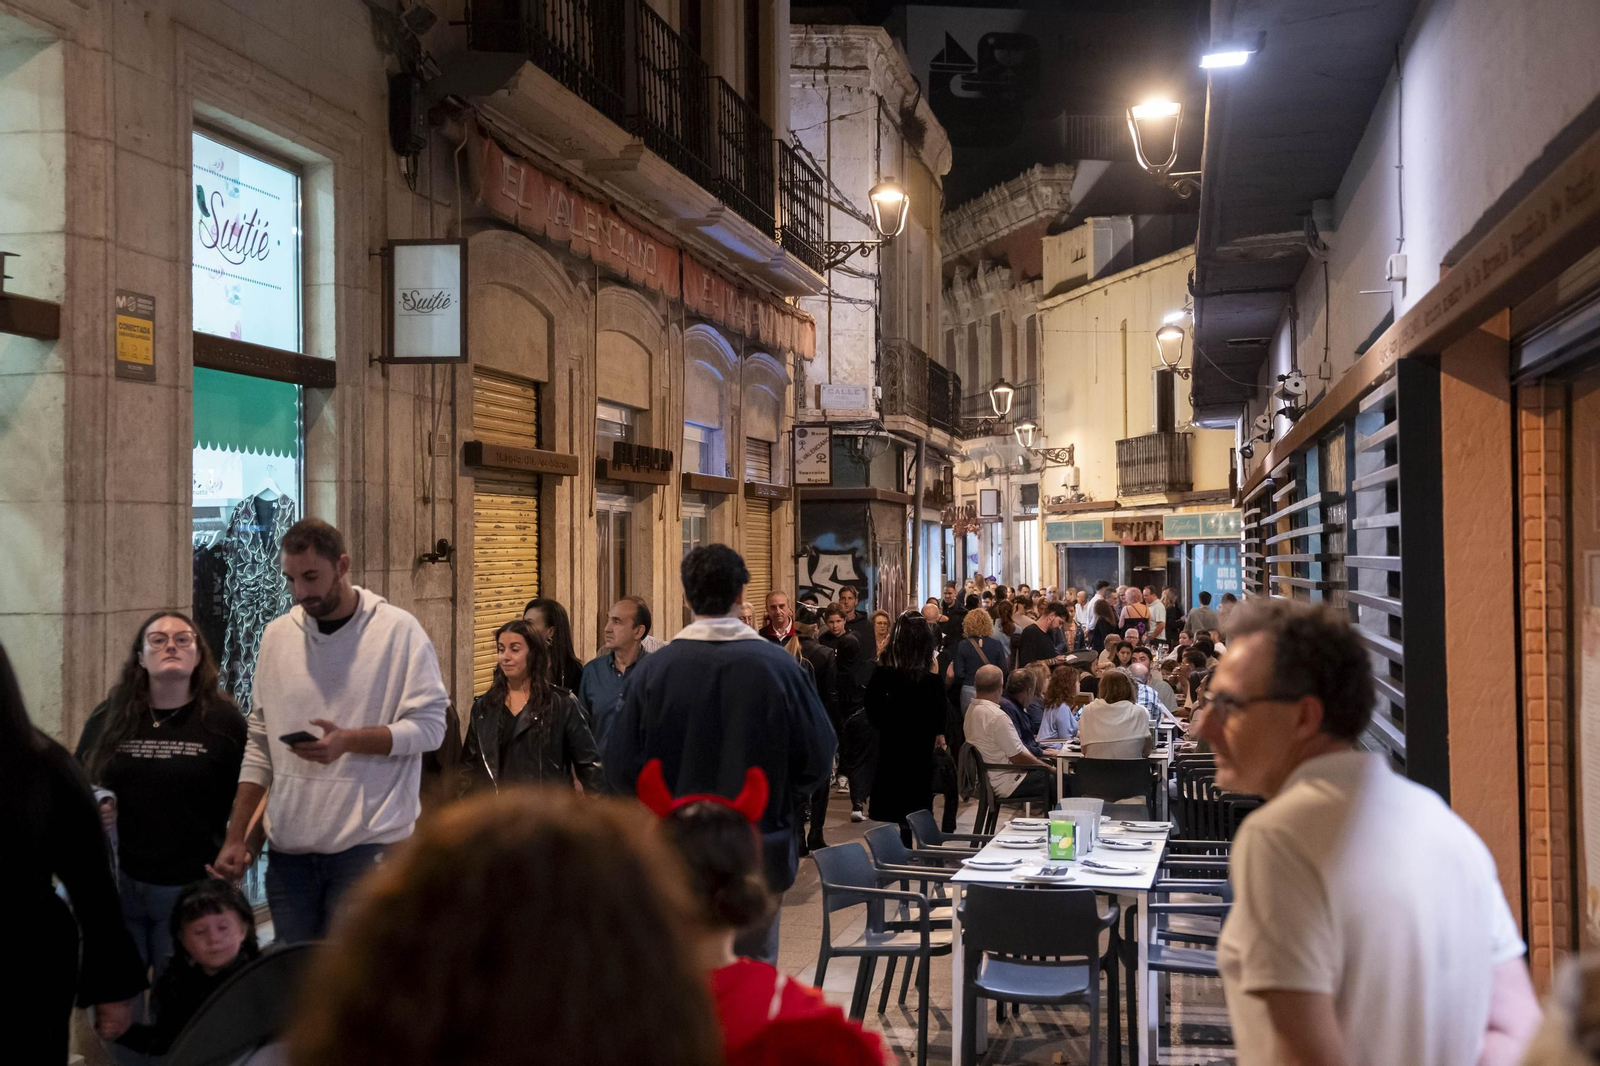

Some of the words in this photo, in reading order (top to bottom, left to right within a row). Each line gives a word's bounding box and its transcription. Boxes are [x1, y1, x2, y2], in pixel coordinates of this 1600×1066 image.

[501, 156, 532, 210] EL
[702, 273, 719, 308] EL
[827, 388, 861, 396] CALLE
[1217, 567, 1229, 578] ESTE
[1229, 567, 1237, 578] ES
[1216, 579, 1224, 590] TU
